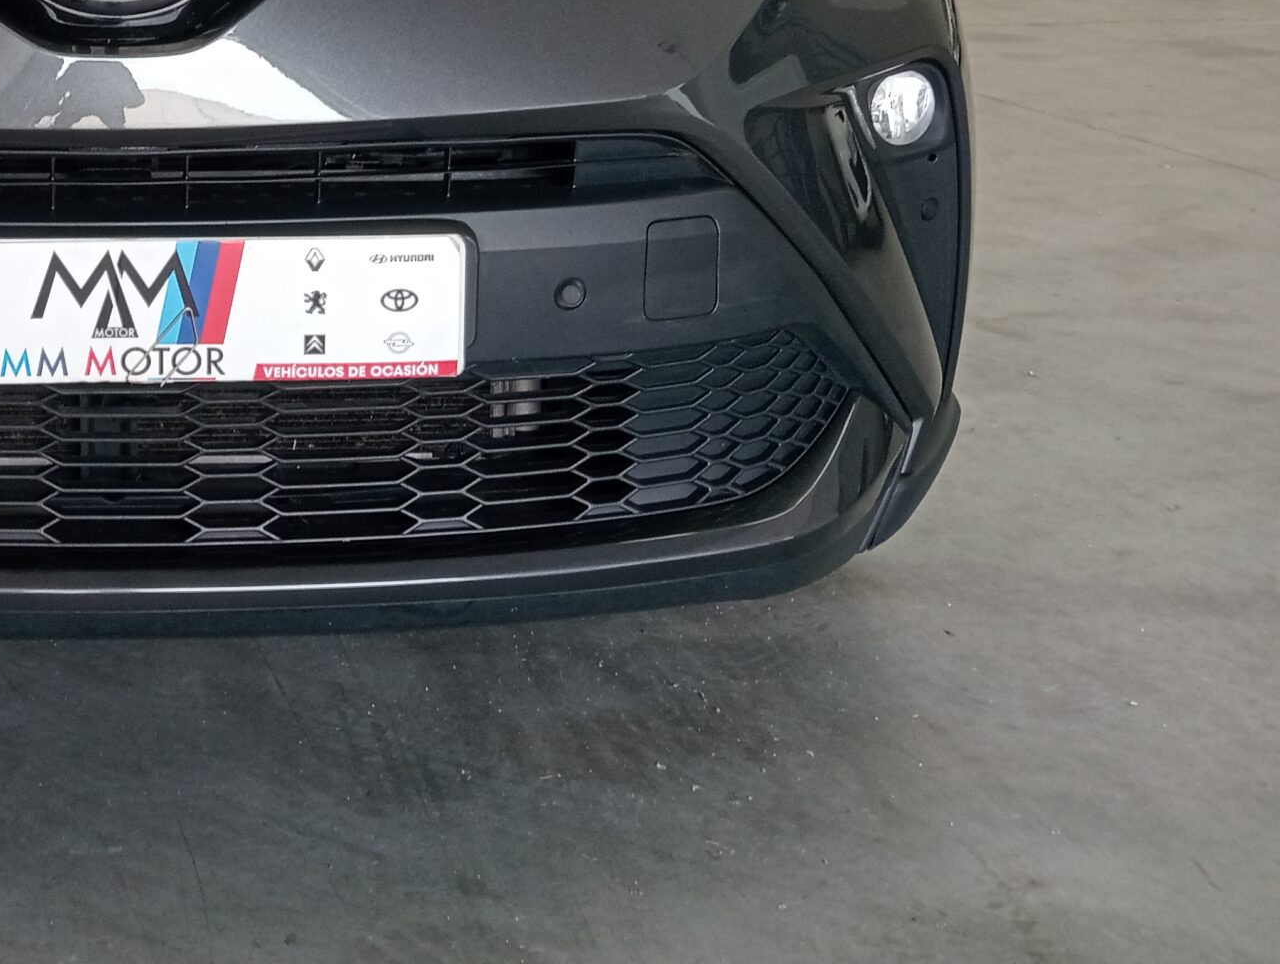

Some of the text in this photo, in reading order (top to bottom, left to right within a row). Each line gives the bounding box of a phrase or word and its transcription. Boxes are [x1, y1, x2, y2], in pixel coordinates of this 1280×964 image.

[389, 253, 435, 263] HYUNDAI
[94, 326, 136, 338] MOTOR
[0, 345, 225, 377] MM MOTOR
[263, 361, 439, 379] VEHÍCULOS DE OCASIÓN
